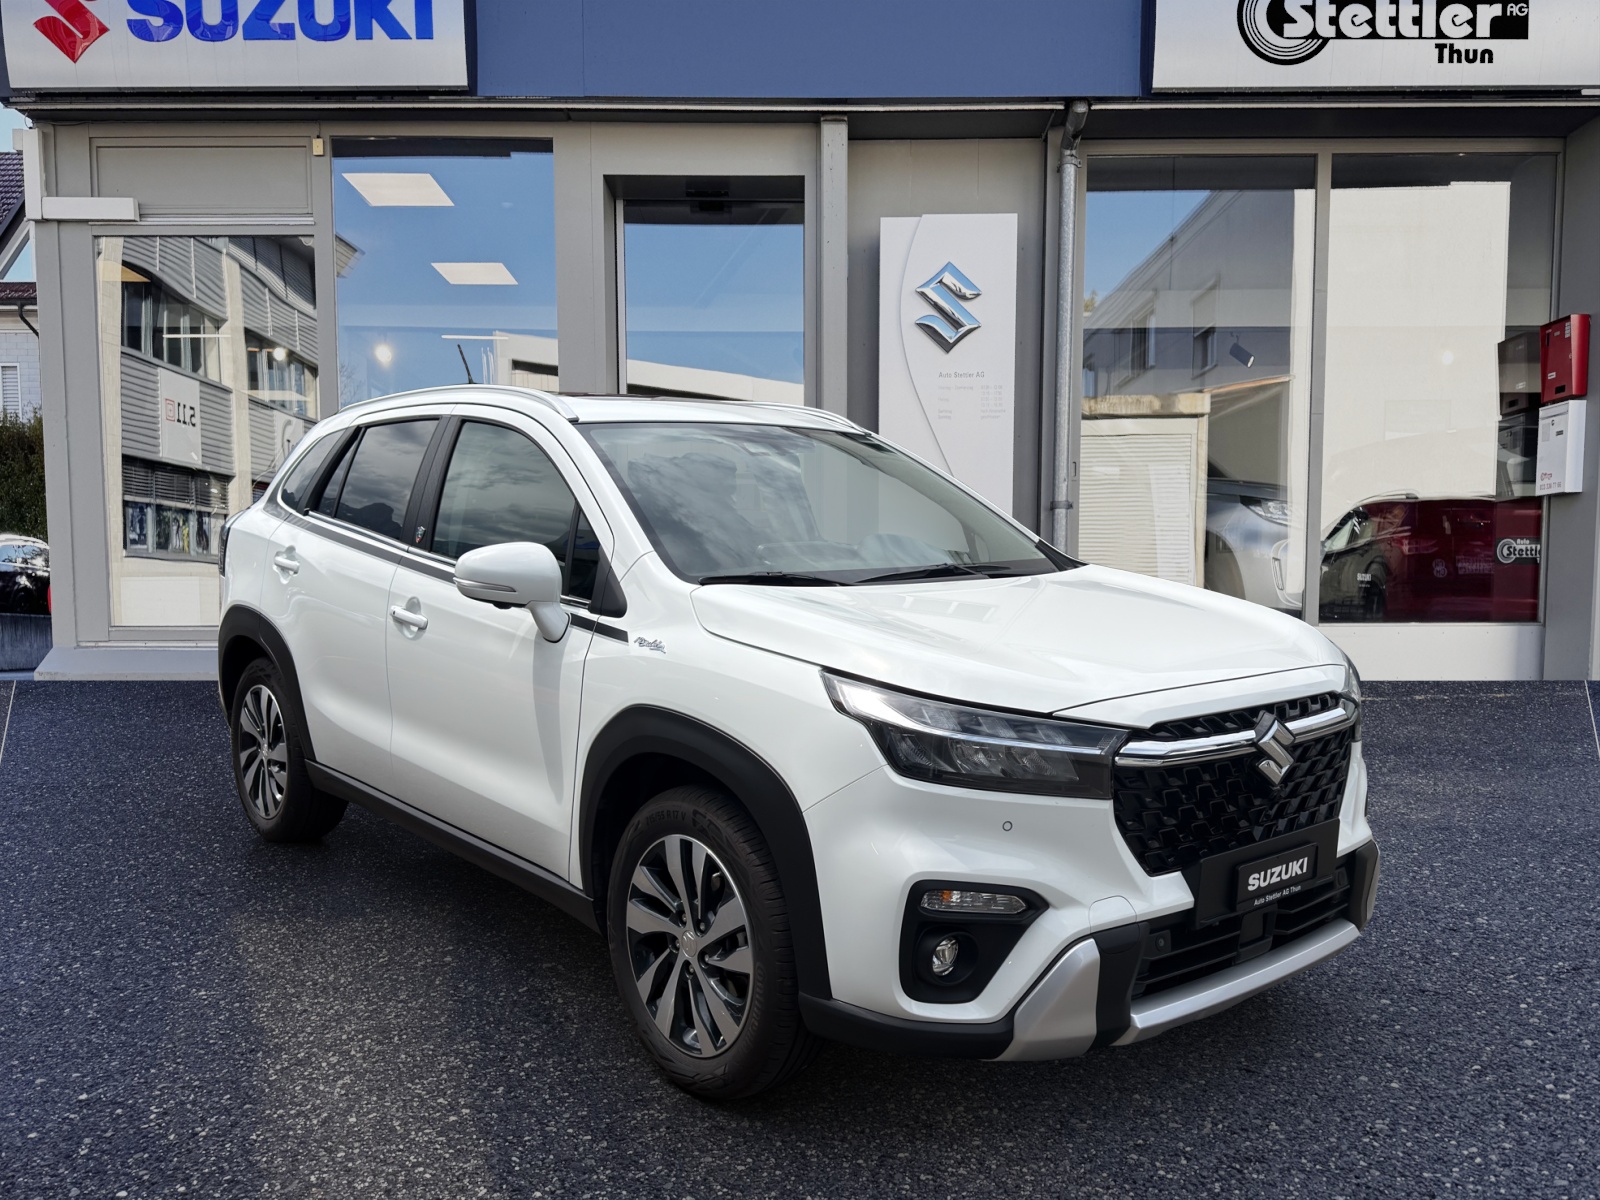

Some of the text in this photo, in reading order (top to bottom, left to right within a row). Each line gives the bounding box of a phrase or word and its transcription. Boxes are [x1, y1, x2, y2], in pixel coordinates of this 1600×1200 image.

[127, 0, 434, 41] SUZUKI
[1283, 0, 1528, 38] Stettler AG
[1435, 43, 1494, 64] Thun
[1247, 857, 1308, 891] SUZUKI
[1254, 885, 1302, 906] Auto Stettler AG Thun
